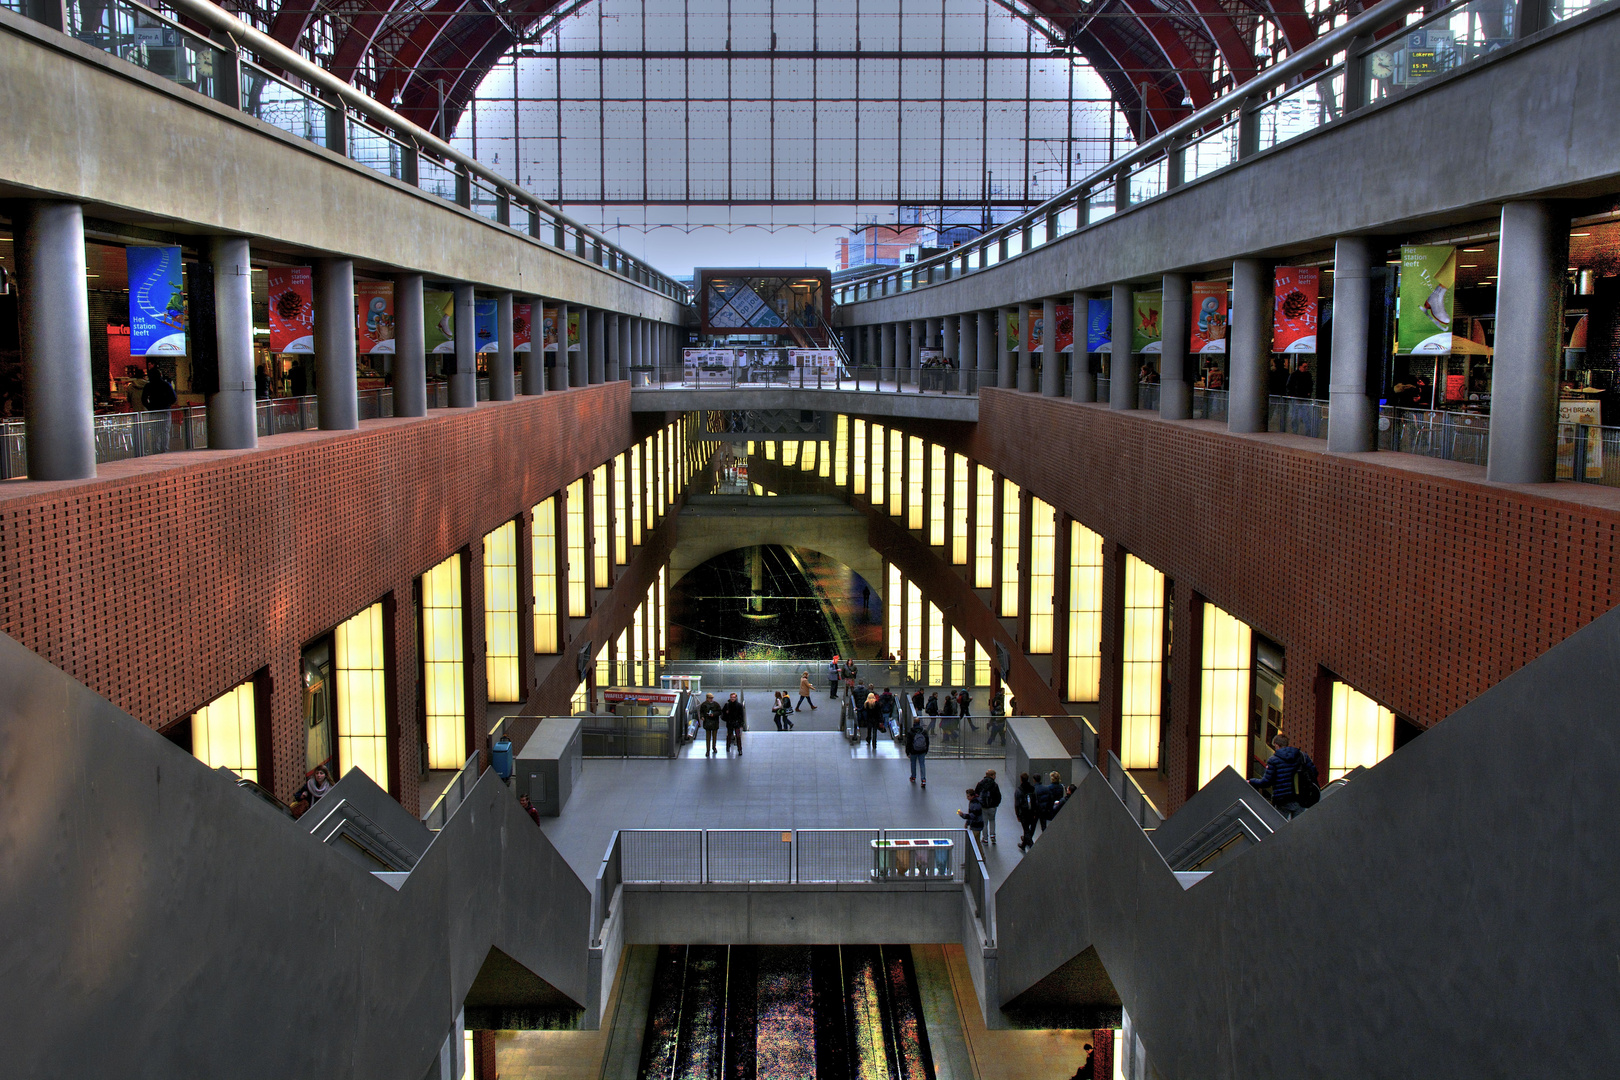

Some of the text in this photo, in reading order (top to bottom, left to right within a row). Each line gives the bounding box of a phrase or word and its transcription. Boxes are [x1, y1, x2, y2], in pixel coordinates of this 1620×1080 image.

[168, 34, 174, 43] 4
[1413, 35, 1421, 45] 3
[739, 305, 750, 316] op
[746, 294, 760, 308] jou
